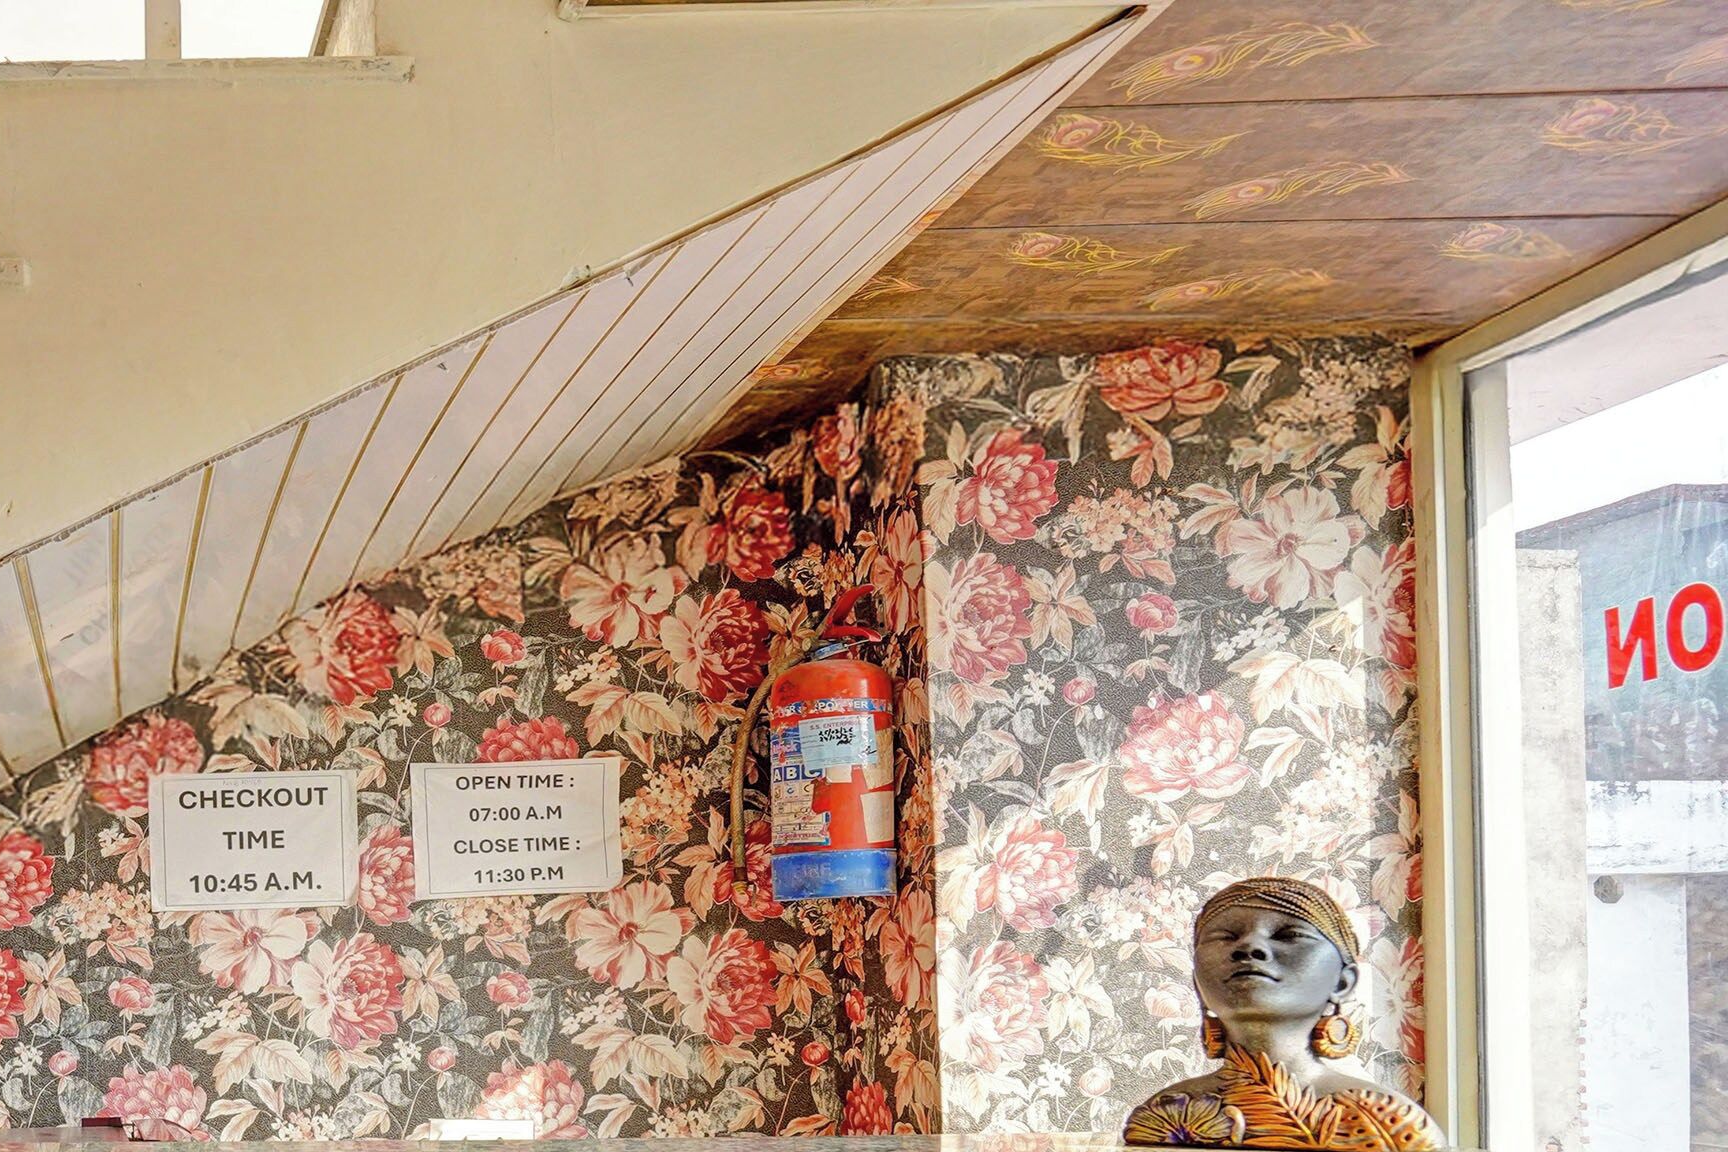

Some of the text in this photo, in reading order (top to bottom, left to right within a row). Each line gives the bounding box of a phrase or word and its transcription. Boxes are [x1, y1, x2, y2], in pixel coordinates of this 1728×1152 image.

[455, 775, 511, 791] OPEN
[516, 773, 564, 789] TIME
[178, 786, 329, 810] CHECKOUT
[469, 805, 562, 822] 07:00 A.M
[222, 829, 285, 850] TIME
[453, 838, 519, 855] CLOSE
[523, 836, 570, 852] TIME
[189, 871, 322, 894] 10:45 A.M.
[474, 866, 564, 884] 11:30 P.M
